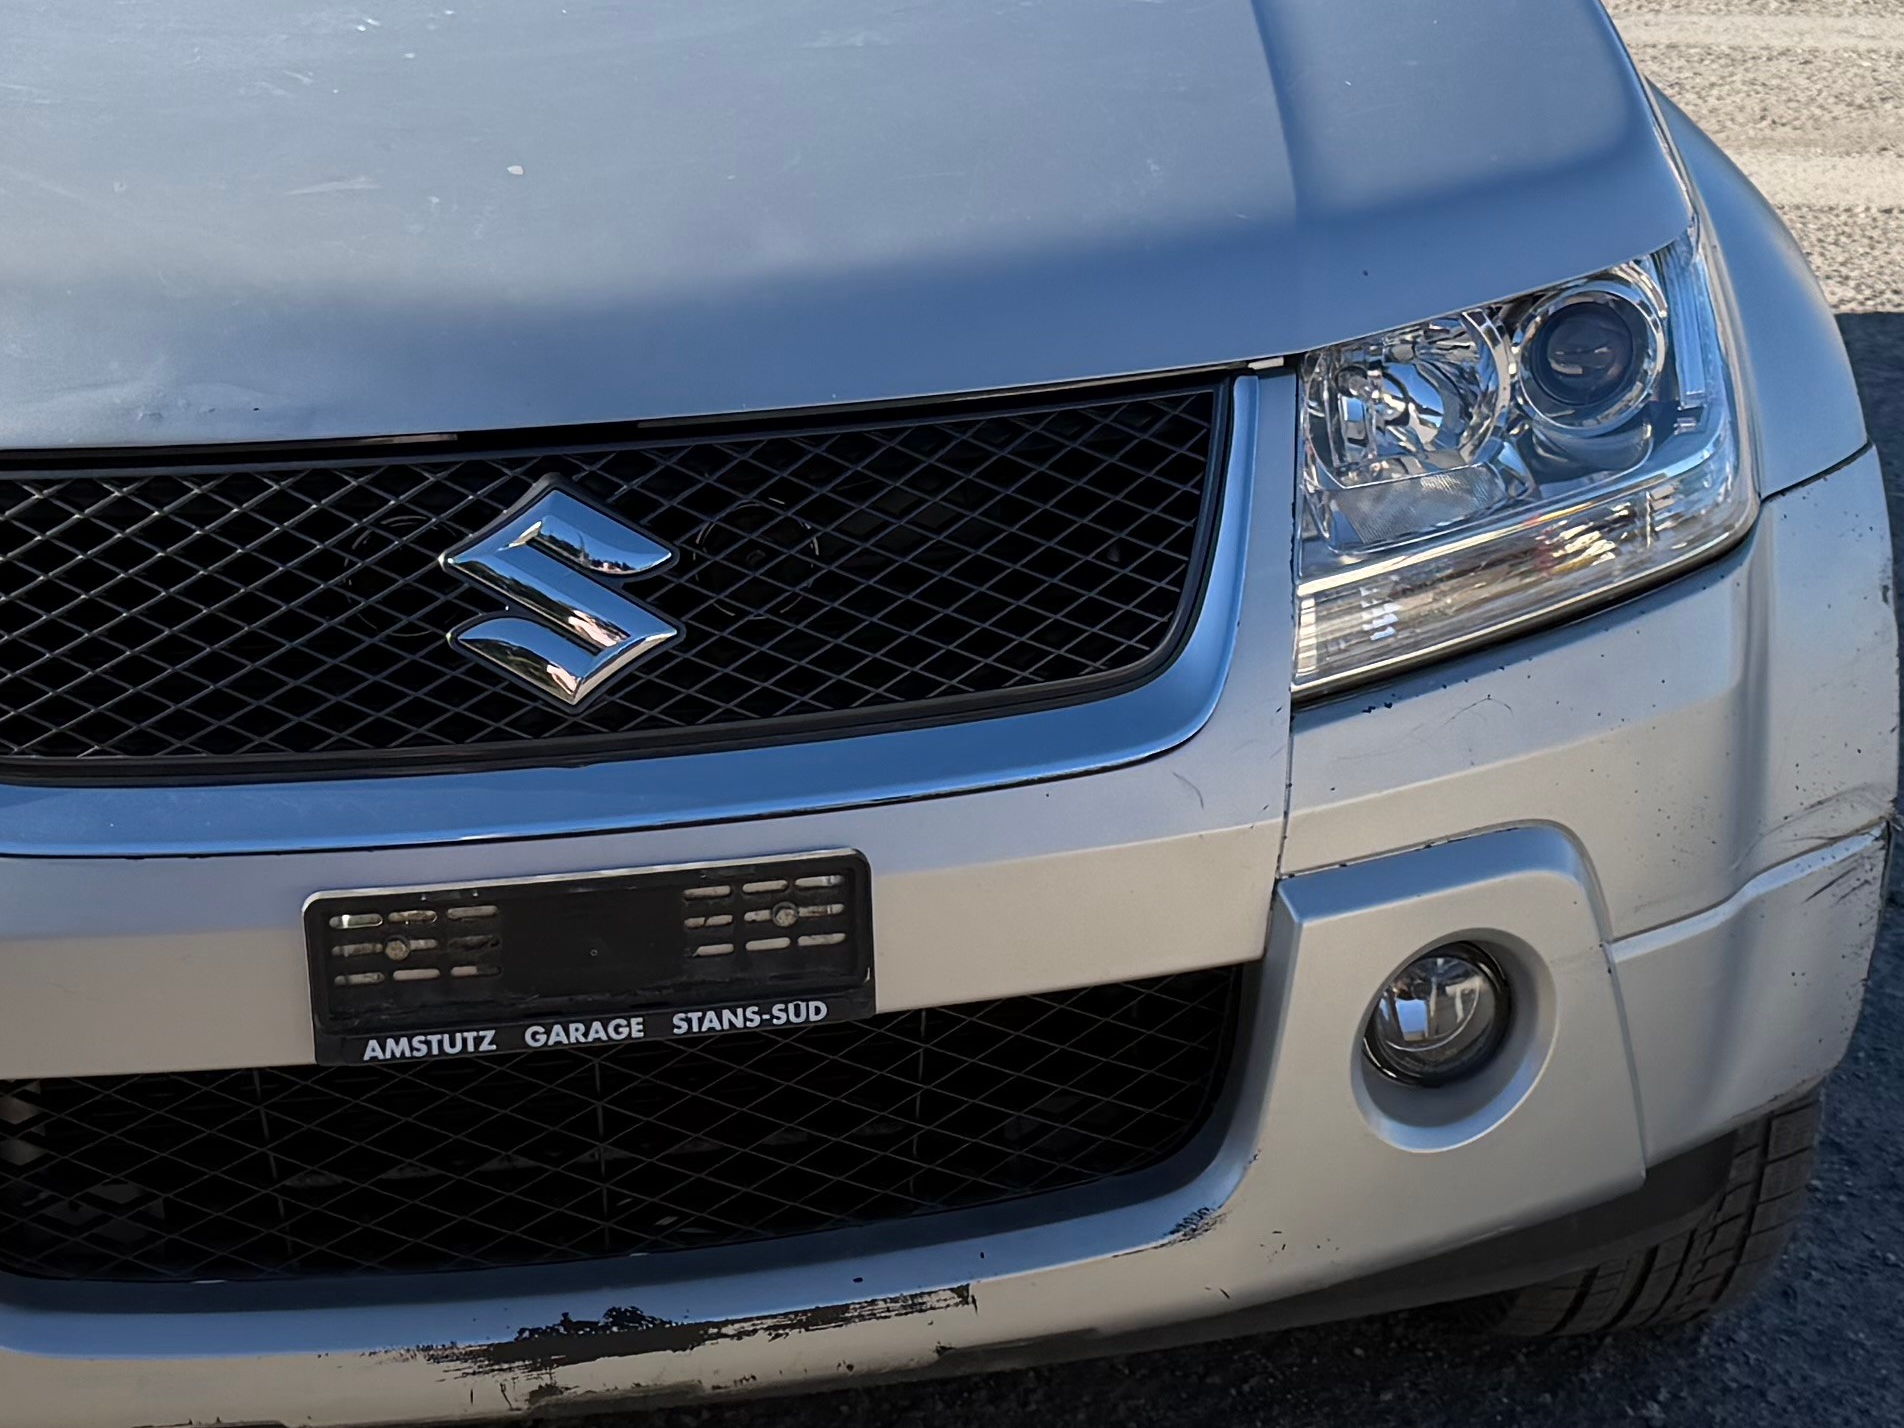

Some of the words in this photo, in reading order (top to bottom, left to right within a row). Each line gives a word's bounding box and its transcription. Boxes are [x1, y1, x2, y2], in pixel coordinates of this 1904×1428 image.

[362, 1028, 497, 1062] AMSTUTZ
[524, 1016, 645, 1048] GARAGE
[671, 999, 828, 1036] STANS-SÜD
